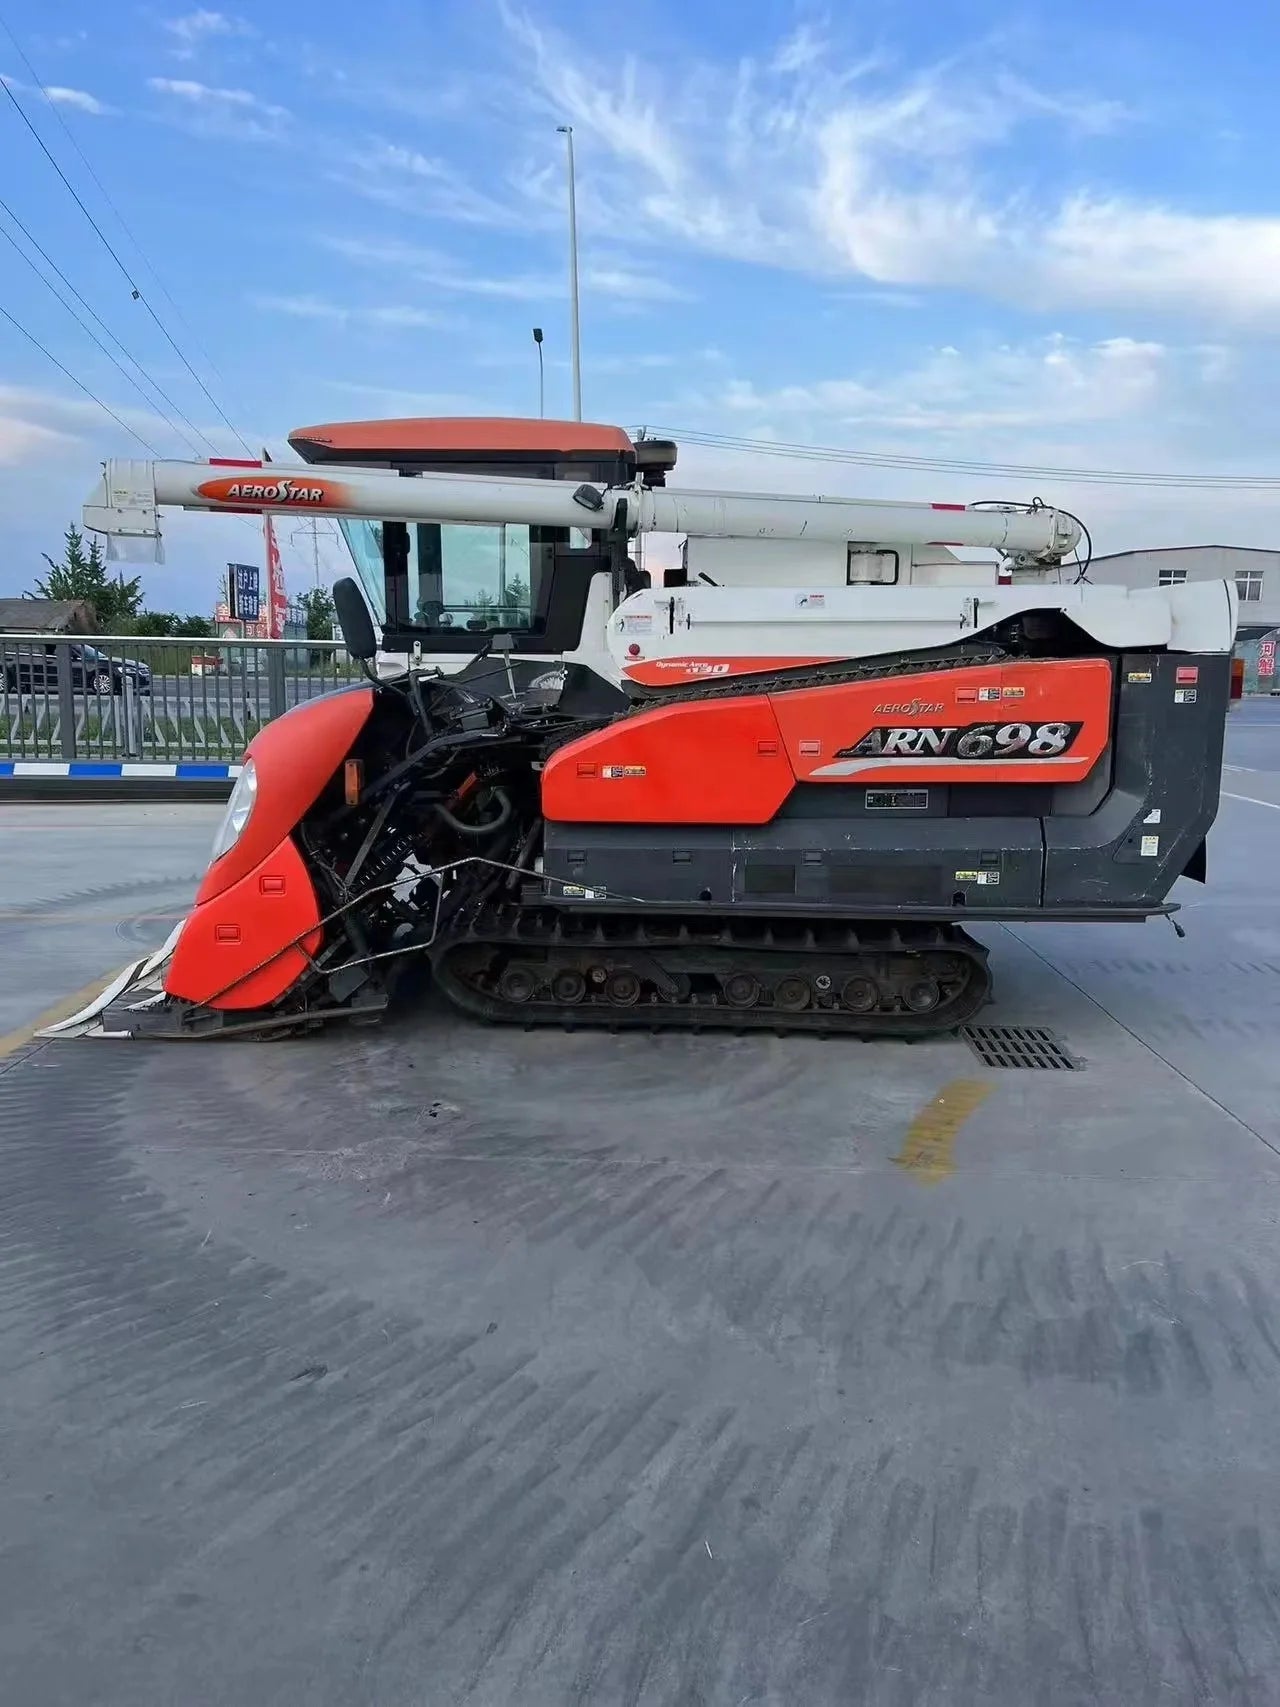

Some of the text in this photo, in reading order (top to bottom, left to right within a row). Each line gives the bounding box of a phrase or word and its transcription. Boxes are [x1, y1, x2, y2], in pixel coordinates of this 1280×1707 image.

[227, 480, 323, 502] AEROSTAR
[656, 661, 688, 670] Dynamic
[1258, 640, 1276, 675] 河蟹
[873, 698, 945, 716] AEROSTAR
[842, 722, 1072, 757] ARN698
